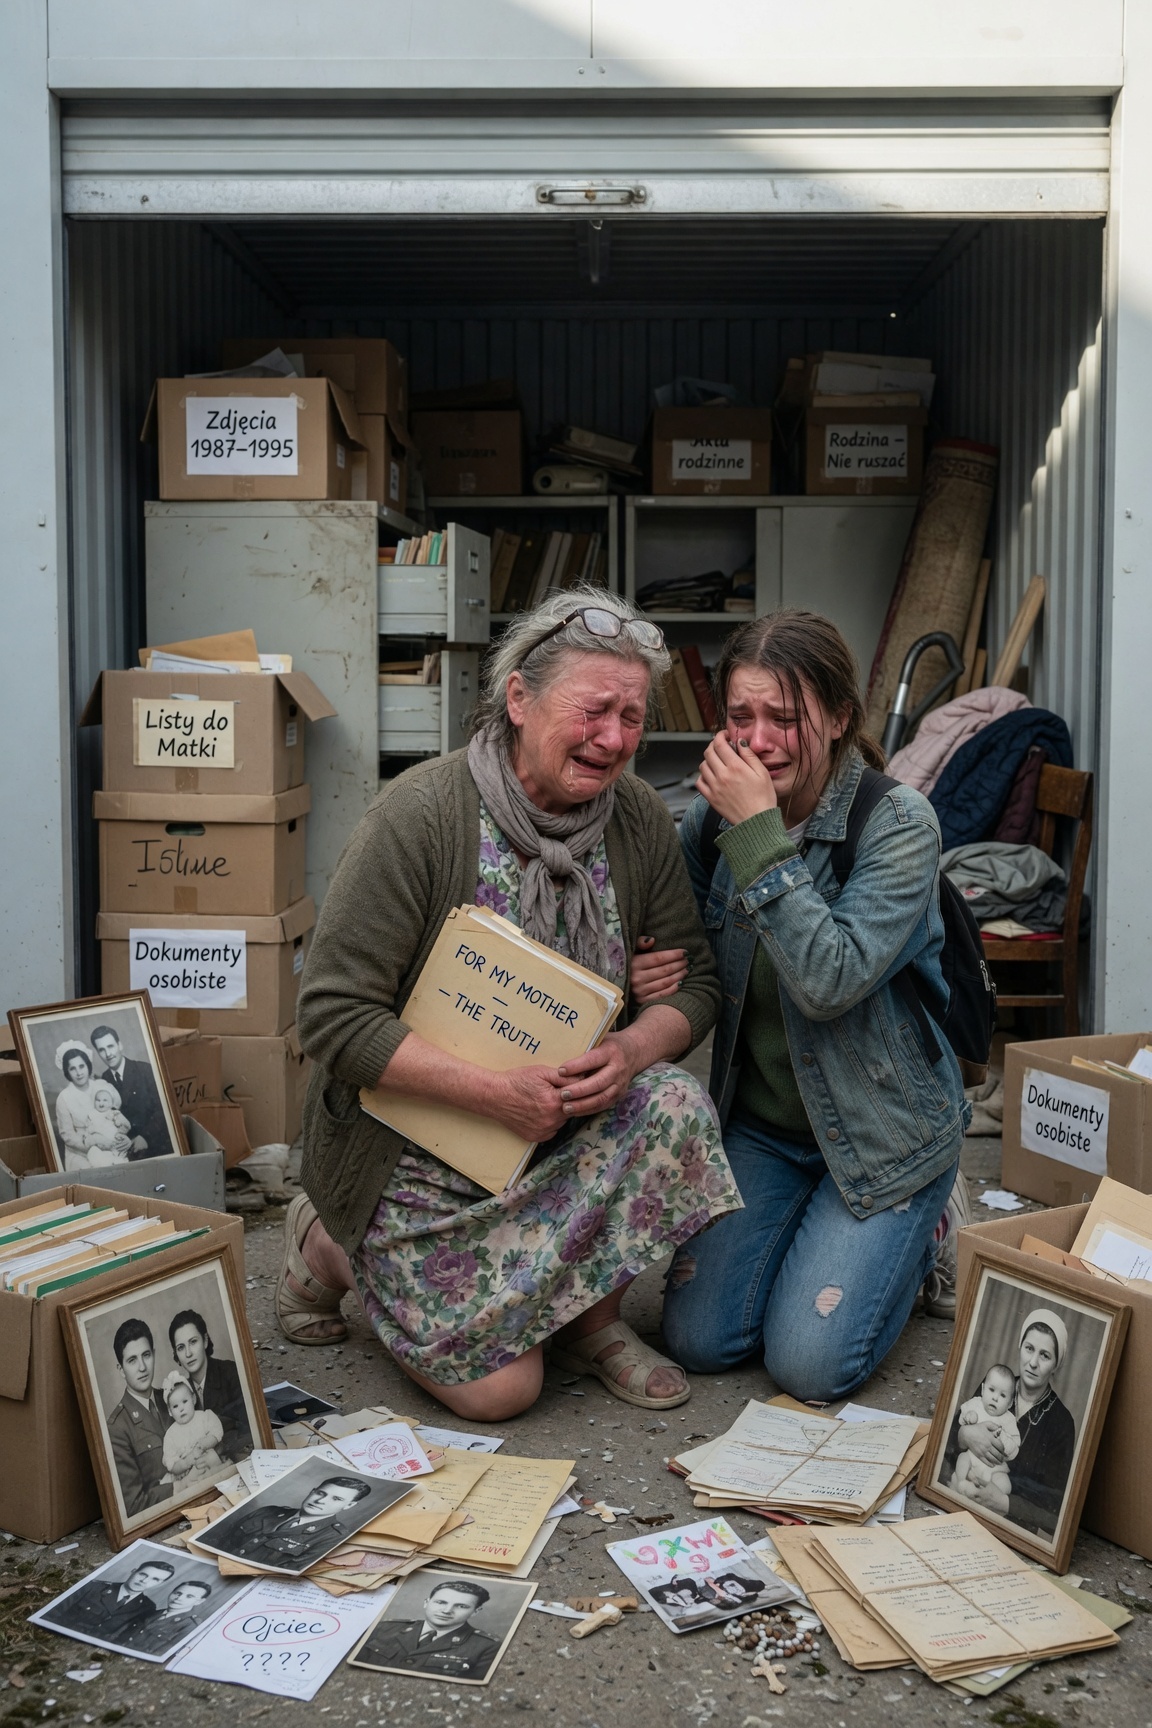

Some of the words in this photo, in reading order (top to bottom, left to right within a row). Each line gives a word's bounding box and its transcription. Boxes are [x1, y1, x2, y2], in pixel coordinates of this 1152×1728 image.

[205, 408, 277, 435] Zdjęcia
[829, 430, 889, 448] Rodzina
[678, 452, 744, 469] rodzinne
[827, 453, 852, 468] Nie
[857, 452, 906, 468] ruszać
[145, 708, 194, 736] Listy
[202, 709, 229, 731] do
[157, 737, 217, 758] Matki
[135, 941, 242, 968] Dokumenty
[149, 969, 227, 989] osobiste
[455, 944, 487, 973] FOR
[489, 965, 516, 988] MY
[516, 981, 579, 1029] MOTHER
[455, 992, 486, 1022] THE
[490, 1014, 541, 1055] TRUTH
[1027, 1084, 1104, 1132] Dokumenty
[1035, 1121, 1091, 1152] osobiste
[242, 1615, 326, 1642] Ojciec
